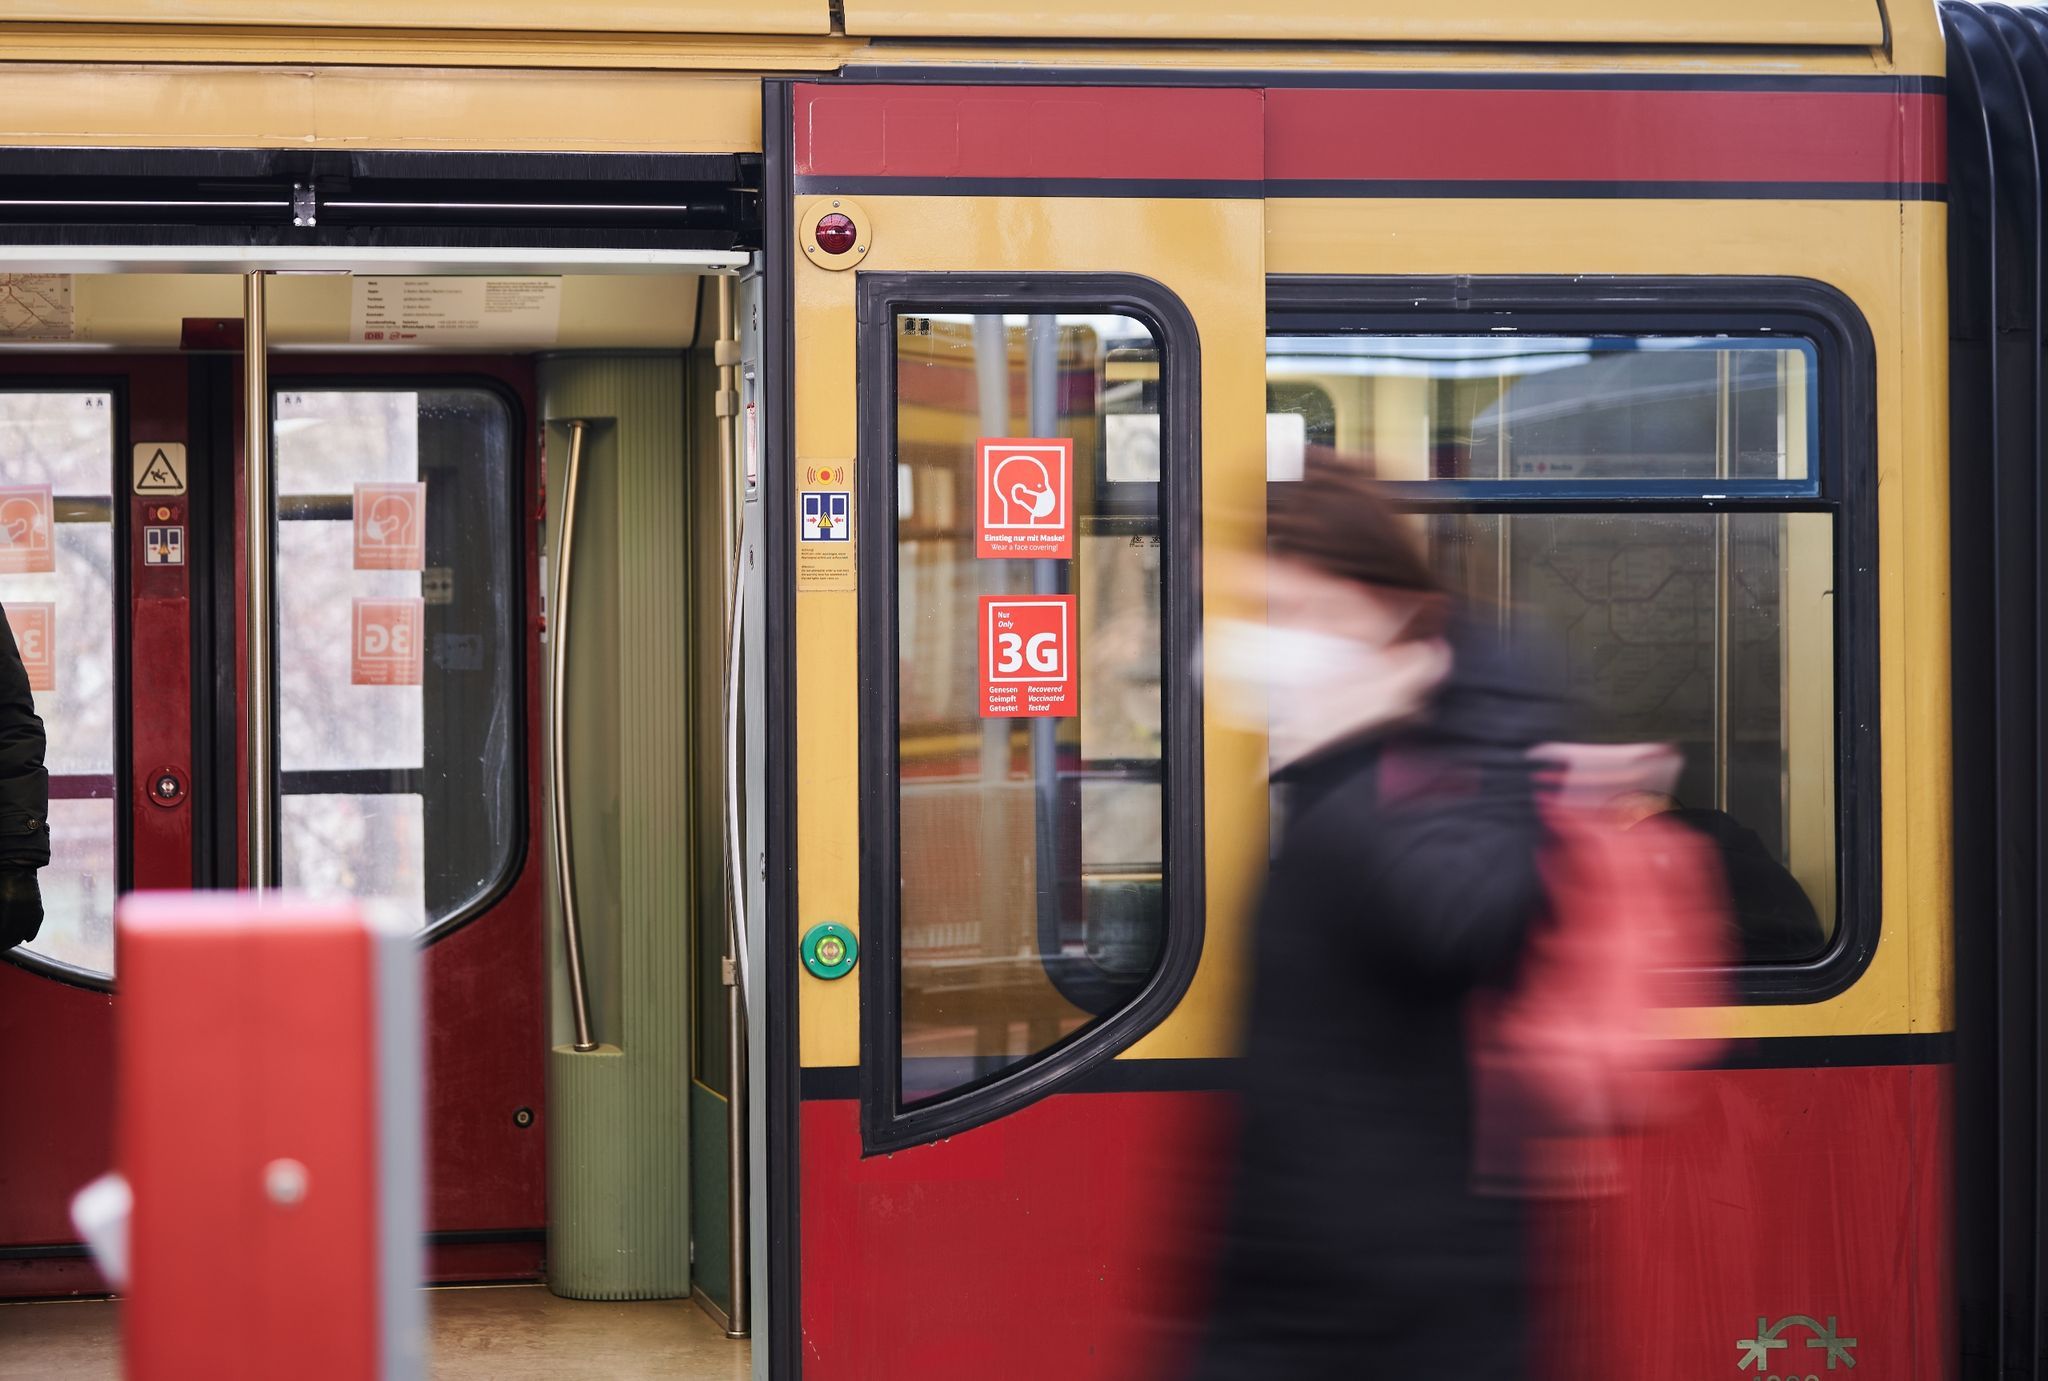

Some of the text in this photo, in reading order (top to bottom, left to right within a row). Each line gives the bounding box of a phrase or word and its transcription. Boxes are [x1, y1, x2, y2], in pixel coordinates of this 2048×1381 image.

[366, 332, 383, 340] DB
[984, 534, 1012, 543] Einstieg
[1027, 534, 1039, 542] mit
[1040, 534, 1065, 542] Maske!
[1014, 543, 1028, 551] face
[1029, 543, 1059, 552] covering!
[998, 620, 1014, 629] Only
[997, 632, 1058, 673] 3G
[1027, 685, 1063, 693] Recovered
[989, 695, 1017, 703] Geimpft
[989, 704, 1050, 712] Getestet Tested
